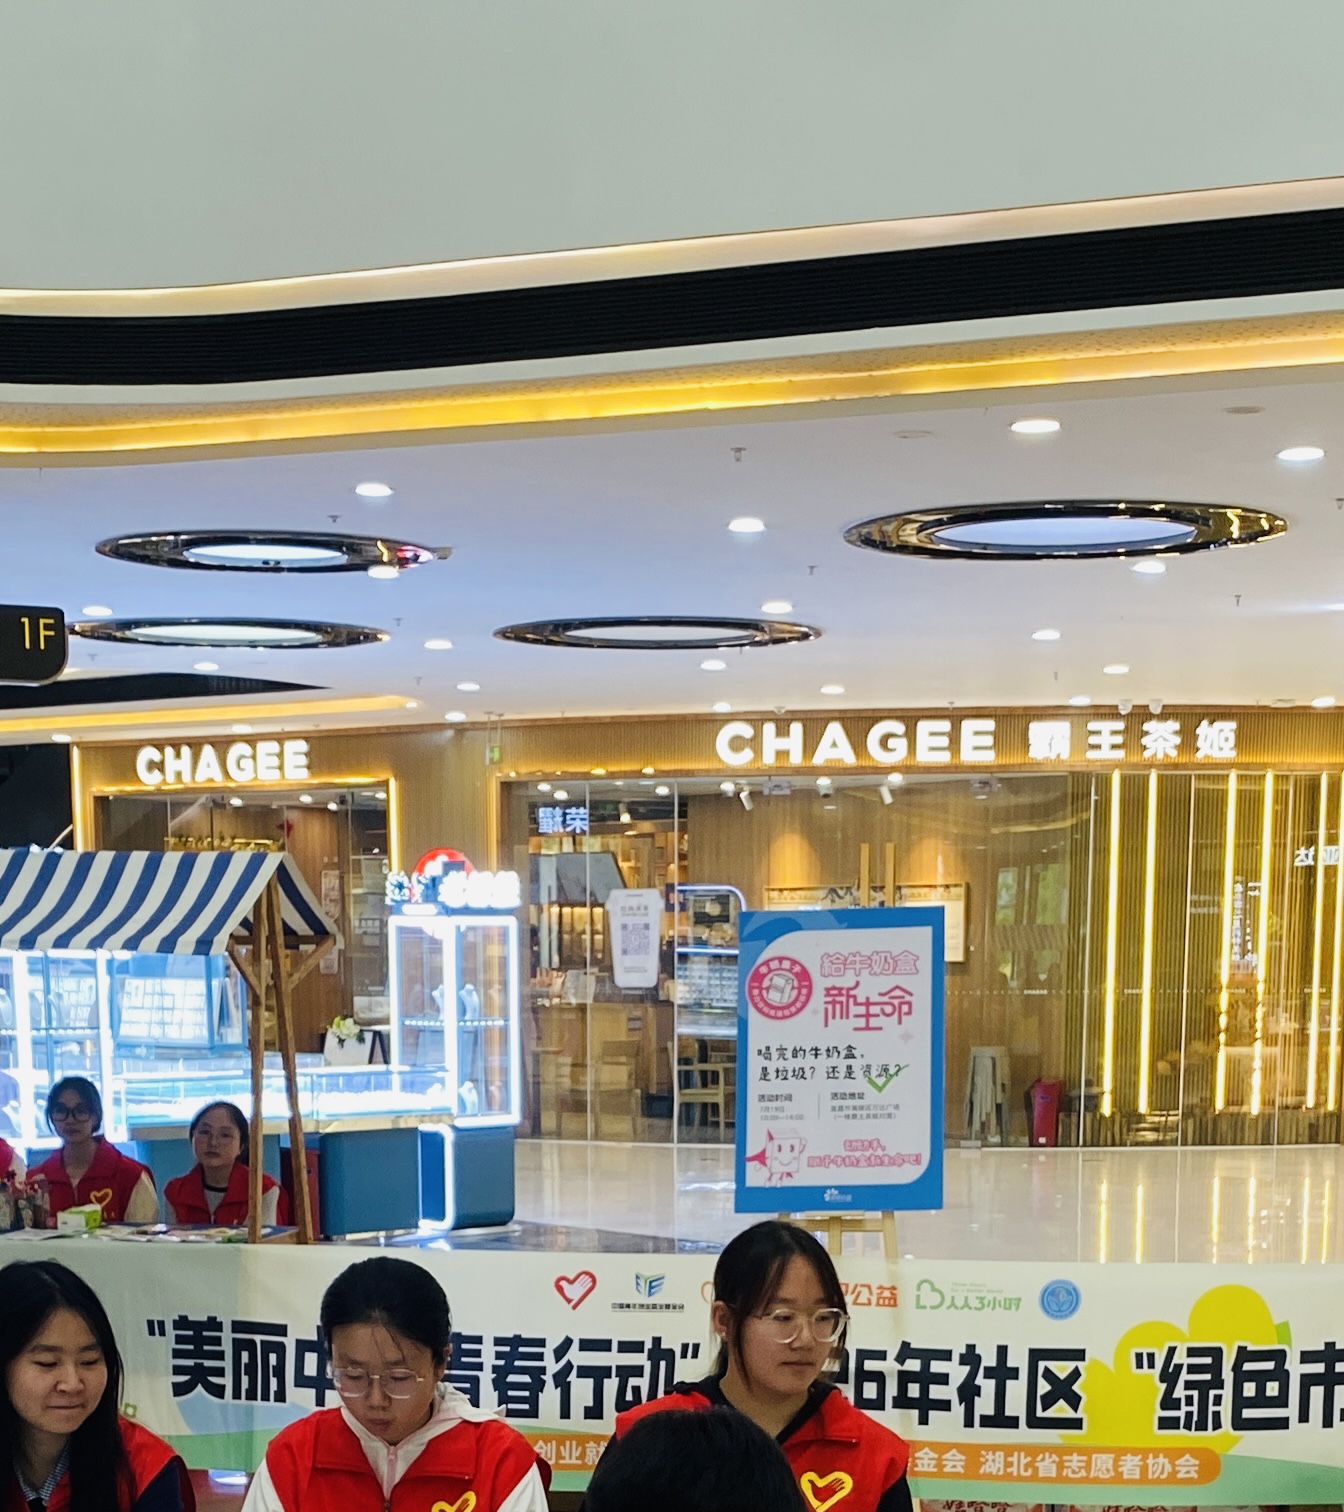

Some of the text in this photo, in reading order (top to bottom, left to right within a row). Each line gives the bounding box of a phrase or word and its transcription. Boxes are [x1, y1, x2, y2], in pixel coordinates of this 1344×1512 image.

[19, 616, 56, 651] 1F
[136, 739, 311, 785] CHAGEE
[715, 719, 1238, 766] CHAGEE 霸王茶姬
[823, 980, 914, 1031] 新生命
[946, 1295, 1023, 1312] 人人3小时
[146, 1314, 333, 1407] “美丽中
[978, 1449, 1200, 1481] 湖北省志愿者协会
